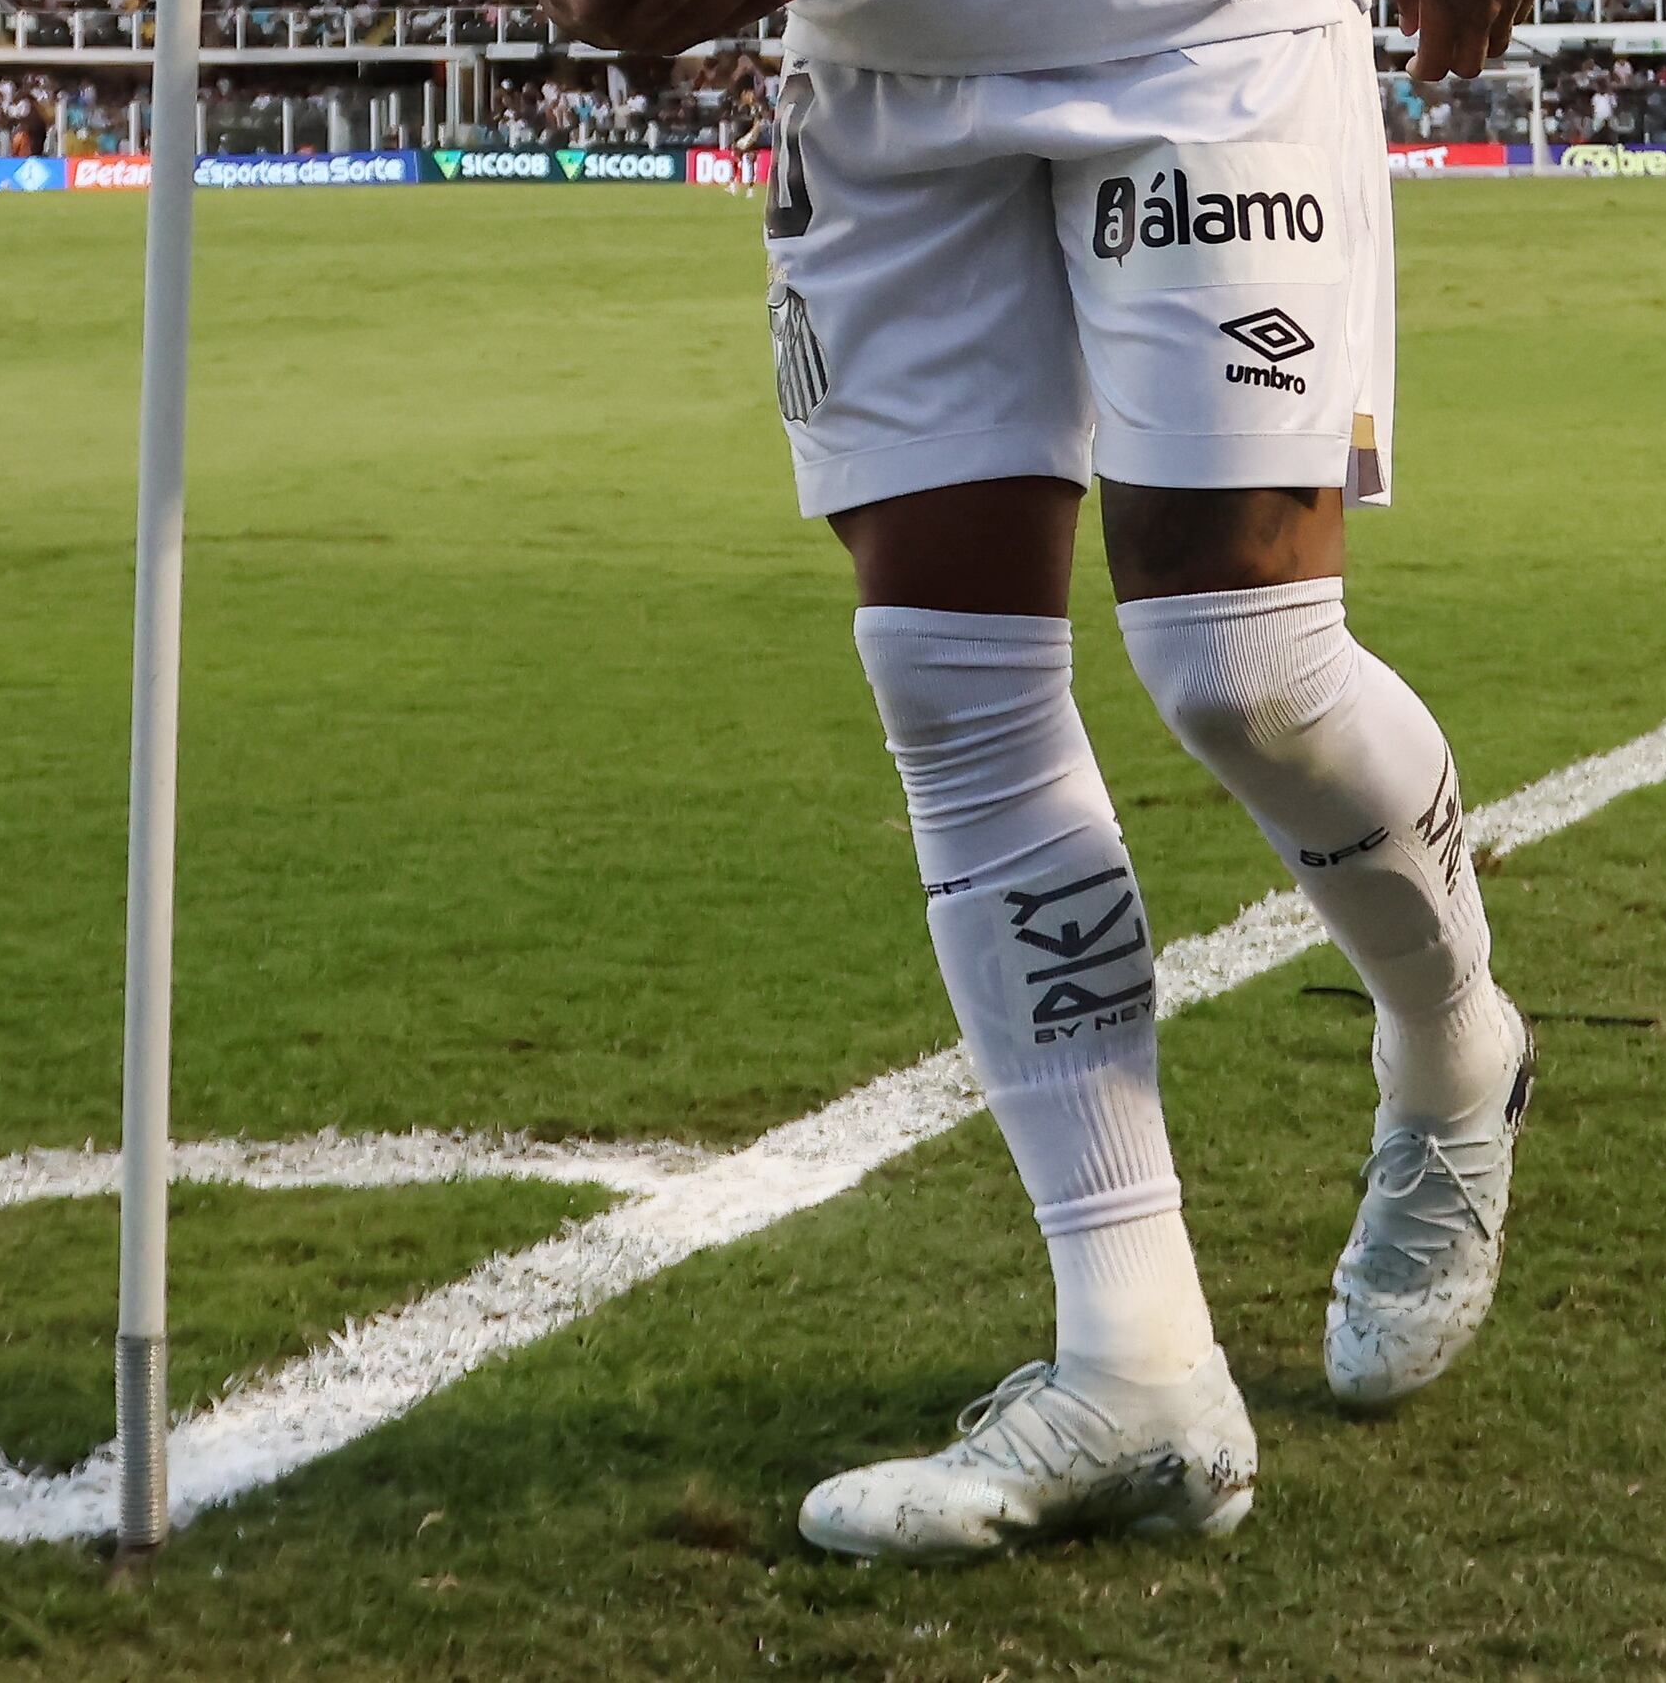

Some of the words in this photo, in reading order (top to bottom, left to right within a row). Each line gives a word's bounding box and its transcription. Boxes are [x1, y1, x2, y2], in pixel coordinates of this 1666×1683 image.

[74, 160, 152, 187] Betan
[461, 150, 550, 179] SICOOB
[584, 152, 674, 180] SICOOB
[1140, 168, 1325, 248] álamo
[1226, 363, 1306, 395] umbro
[1034, 1022, 1082, 1044] BY
